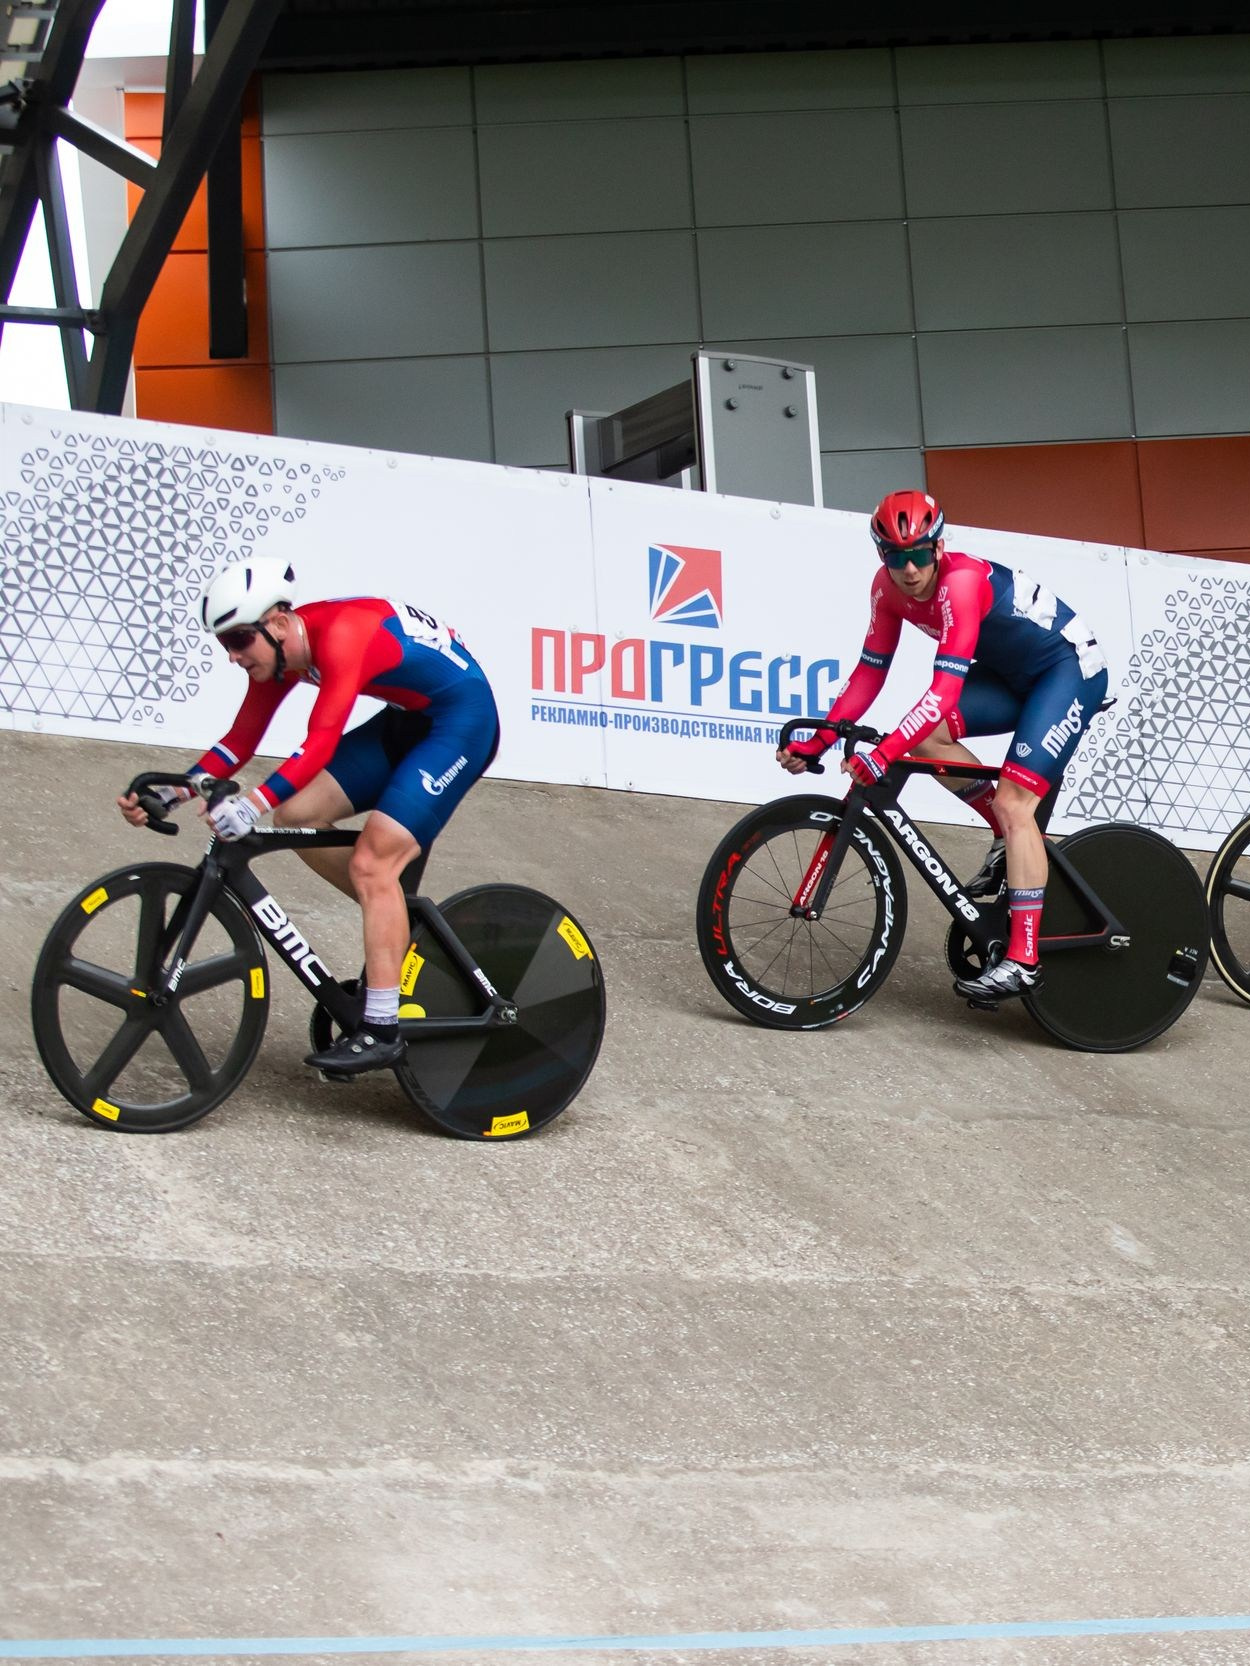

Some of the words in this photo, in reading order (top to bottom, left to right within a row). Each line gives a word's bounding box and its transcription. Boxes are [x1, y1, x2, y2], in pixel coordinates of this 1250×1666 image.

[531, 627, 840, 718] ПРОГРЕСС
[531, 704, 762, 743] РЕКЛАМНО-ПРОИЗВОДСТВЕННАЯ
[800, 864, 822, 906] ARGON
[883, 809, 959, 896] ARGON
[955, 893, 980, 922] 18
[713, 851, 742, 956] ULTRA
[252, 895, 333, 987] BMC
[565, 927, 584, 950] MAVIC
[1025, 913, 1034, 958] Santic
[168, 957, 186, 993] BMC
[402, 961, 417, 988] MAVIC
[723, 960, 798, 1015] BORA
[499, 1119, 523, 1130] MAVIC
